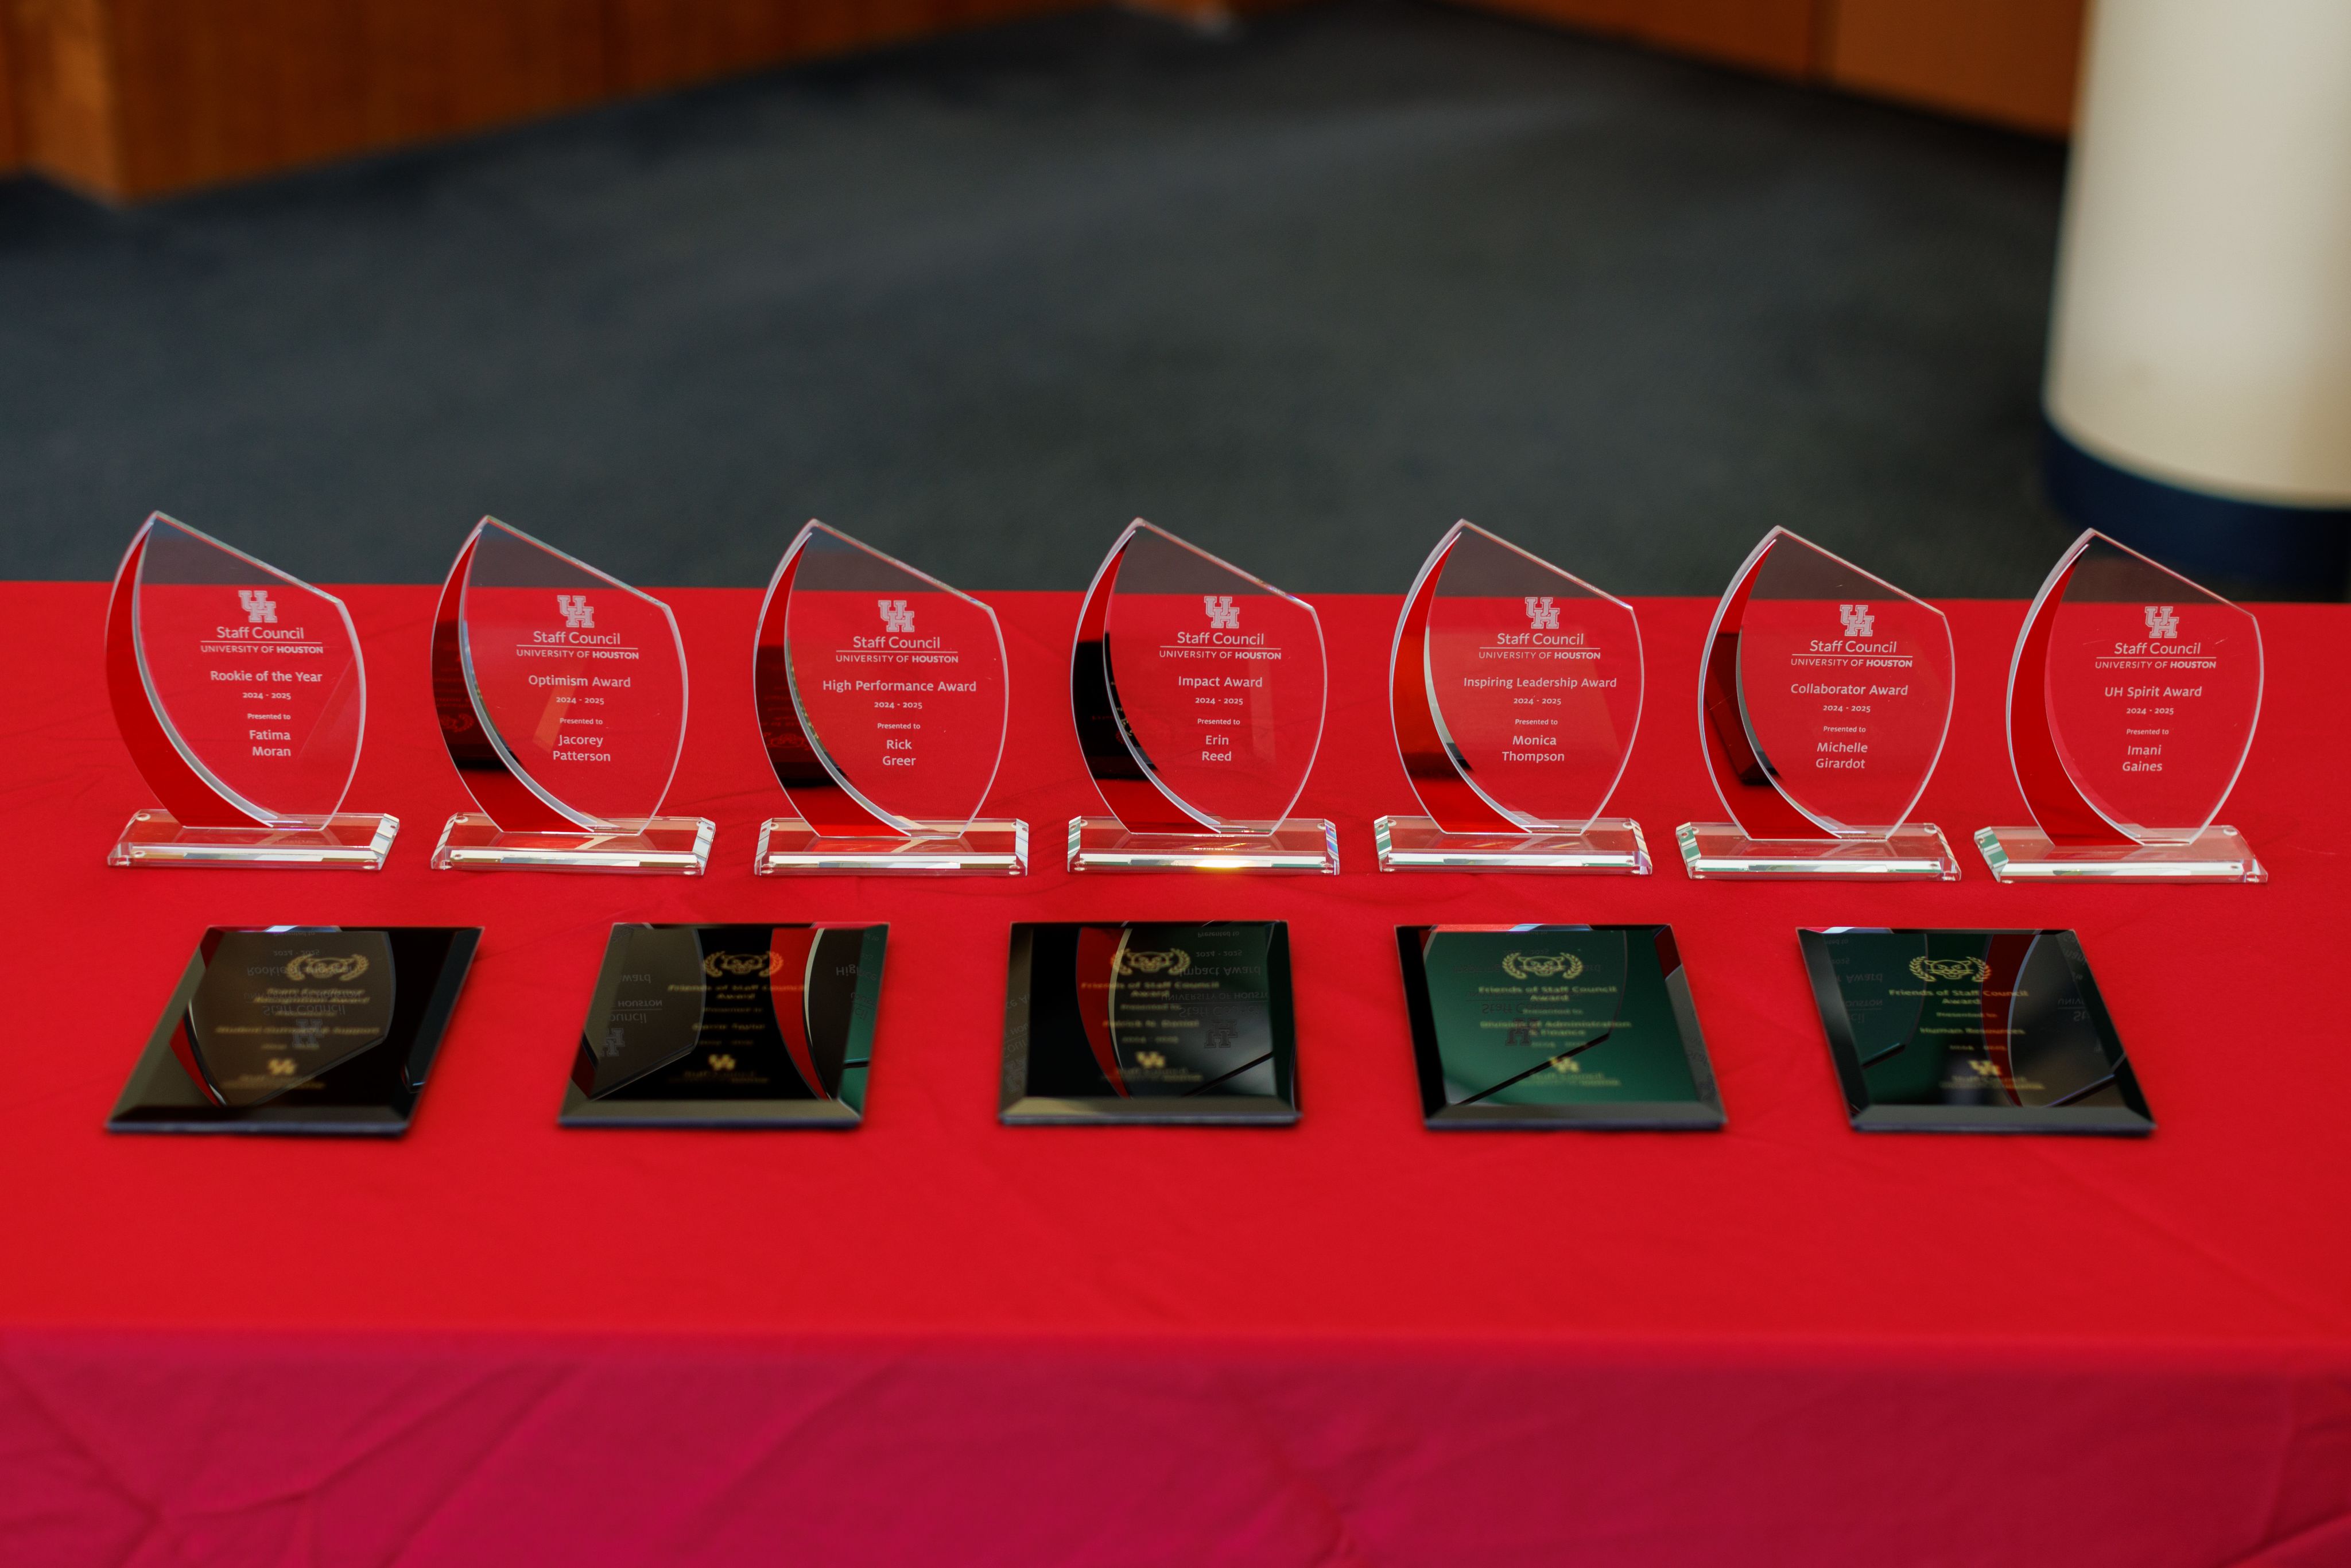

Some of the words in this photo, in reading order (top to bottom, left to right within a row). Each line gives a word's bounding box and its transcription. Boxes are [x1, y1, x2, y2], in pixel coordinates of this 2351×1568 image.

[238, 590, 278, 623] UH
[557, 595, 595, 628] UH
[1204, 596, 1240, 629] UH
[878, 600, 914, 632] UH
[1525, 597, 1560, 629] UH
[1840, 604, 1875, 636] UH
[2144, 606, 2179, 638] UH
[216, 627, 249, 639] Staff
[253, 627, 304, 639] Council
[533, 631, 566, 643] Staff
[569, 632, 620, 645] Council
[1177, 632, 1210, 643] Staff
[1213, 632, 1264, 645] Council
[1497, 633, 1530, 645] Staff
[1533, 633, 1584, 645] Council
[853, 636, 886, 648] Staff
[889, 636, 940, 649] Council
[1809, 640, 1843, 652] Staff
[1845, 641, 1897, 653] Council
[2114, 642, 2147, 654] Staff
[2150, 642, 2201, 654] Council
[200, 645, 258, 653] UNIVERSITY
[517, 649, 574, 658] UNIVERSITY
[592, 651, 639, 659] HOUSTON
[1159, 650, 1217, 658] UNIVERSITY
[1235, 651, 1282, 660] HOUSTON
[912, 655, 959, 663] HOUSTON
[1791, 658, 1848, 666] UNIVERSITY
[1866, 659, 1912, 667] HOUSTON
[211, 671, 252, 681] Rookie
[256, 671, 269, 681] of
[271, 672, 292, 681] the
[295, 672, 323, 682] Year
[529, 675, 588, 687] Optimism
[592, 677, 631, 687] Award
[1178, 676, 1220, 688] Impact
[1224, 677, 1263, 687] Award
[823, 680, 851, 693] High
[856, 681, 934, 692] Performance
[938, 681, 976, 692] Award
[1464, 677, 1513, 689] Inspiring
[1516, 677, 1578, 689] Leadership
[1581, 678, 1616, 688] Award
[1791, 684, 1866, 695] Collaborator
[1869, 685, 1908, 696] Award
[2105, 687, 2123, 697] UH
[2127, 686, 2160, 698] Spirit
[2163, 686, 2202, 697] Award
[249, 730, 291, 740] Fatima
[558, 735, 603, 747] Jacorey
[1205, 735, 1229, 745] Erin
[1512, 735, 1557, 745] Monica
[886, 739, 912, 750] Rick
[1817, 742, 1868, 752] Michelle
[2127, 744, 2162, 755] Imani
[252, 747, 291, 756] Moran
[553, 751, 611, 762] Patterson
[1202, 751, 1232, 762] Reed
[1502, 751, 1565, 763] Thompson
[882, 755, 916, 766] Greer
[1815, 758, 1865, 769] Girardot
[2123, 762, 2162, 771] Gaines
